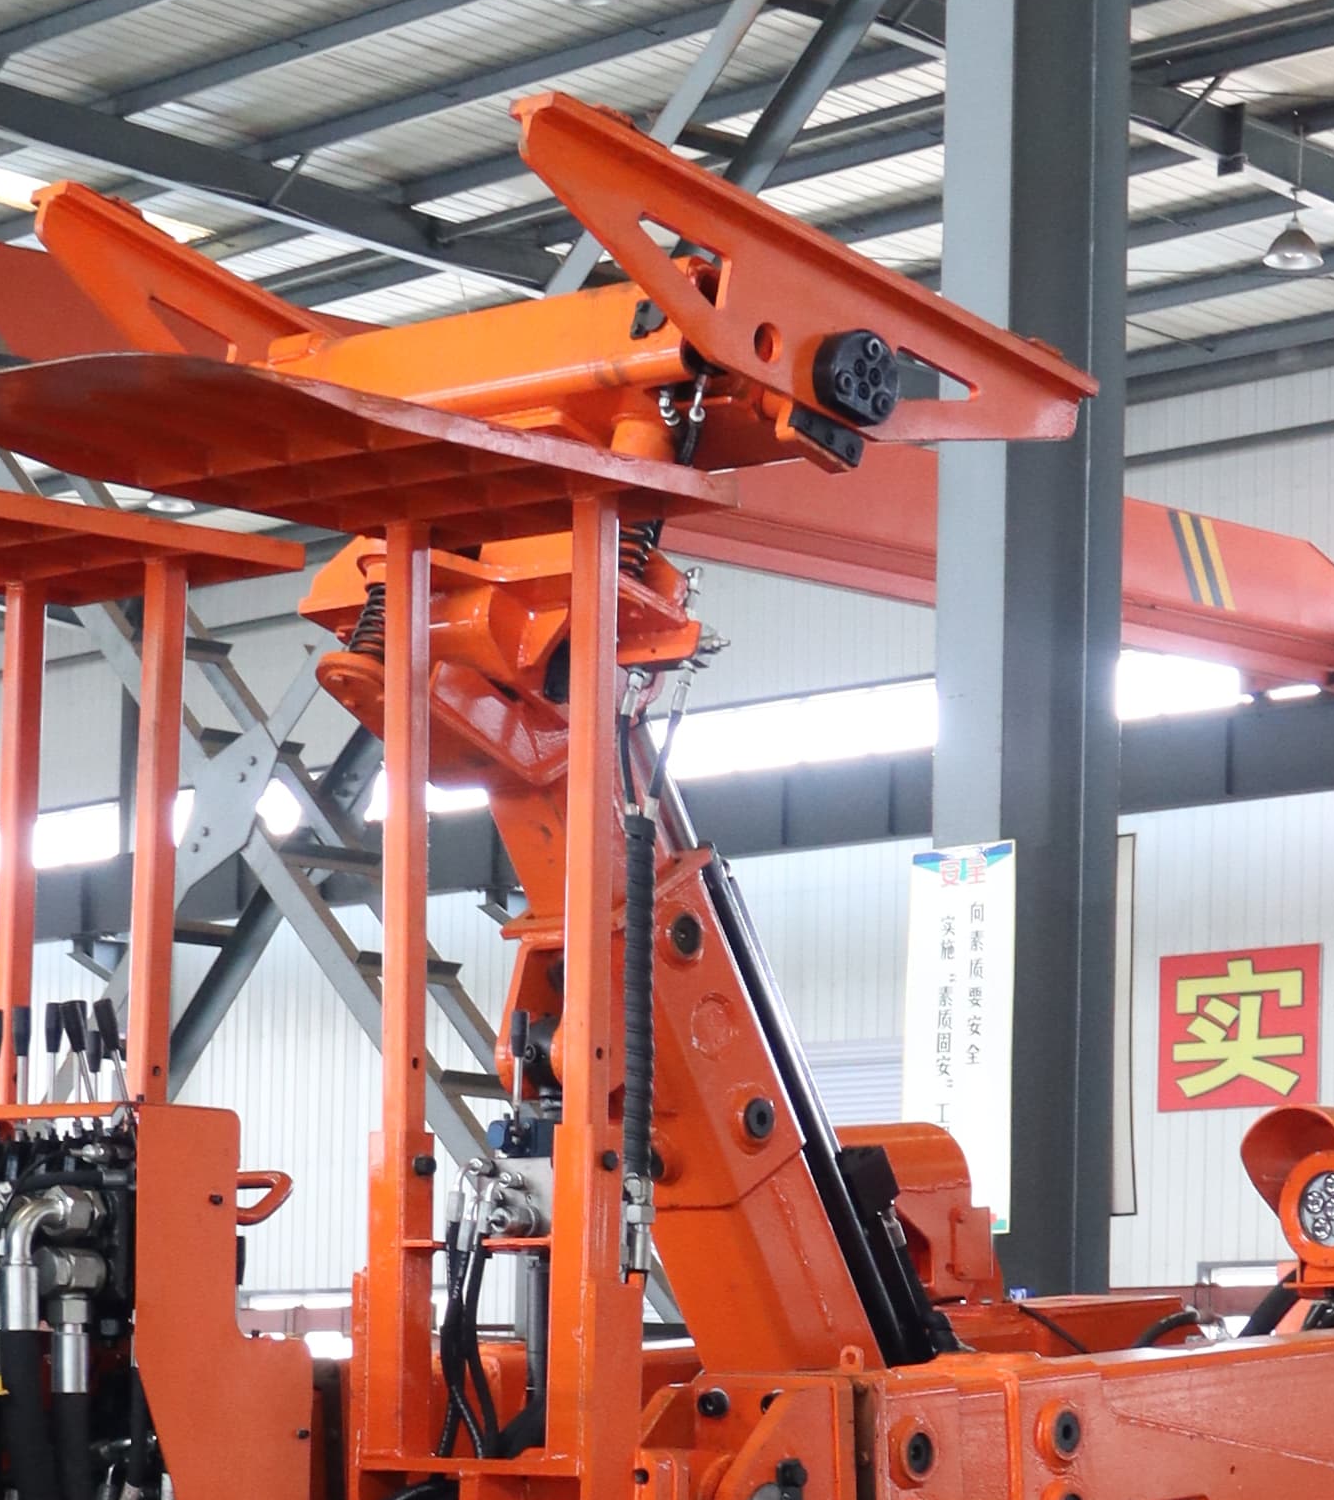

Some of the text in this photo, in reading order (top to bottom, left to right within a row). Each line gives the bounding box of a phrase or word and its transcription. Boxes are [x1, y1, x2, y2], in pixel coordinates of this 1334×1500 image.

[965, 901, 985, 1065] 向素质要安全
